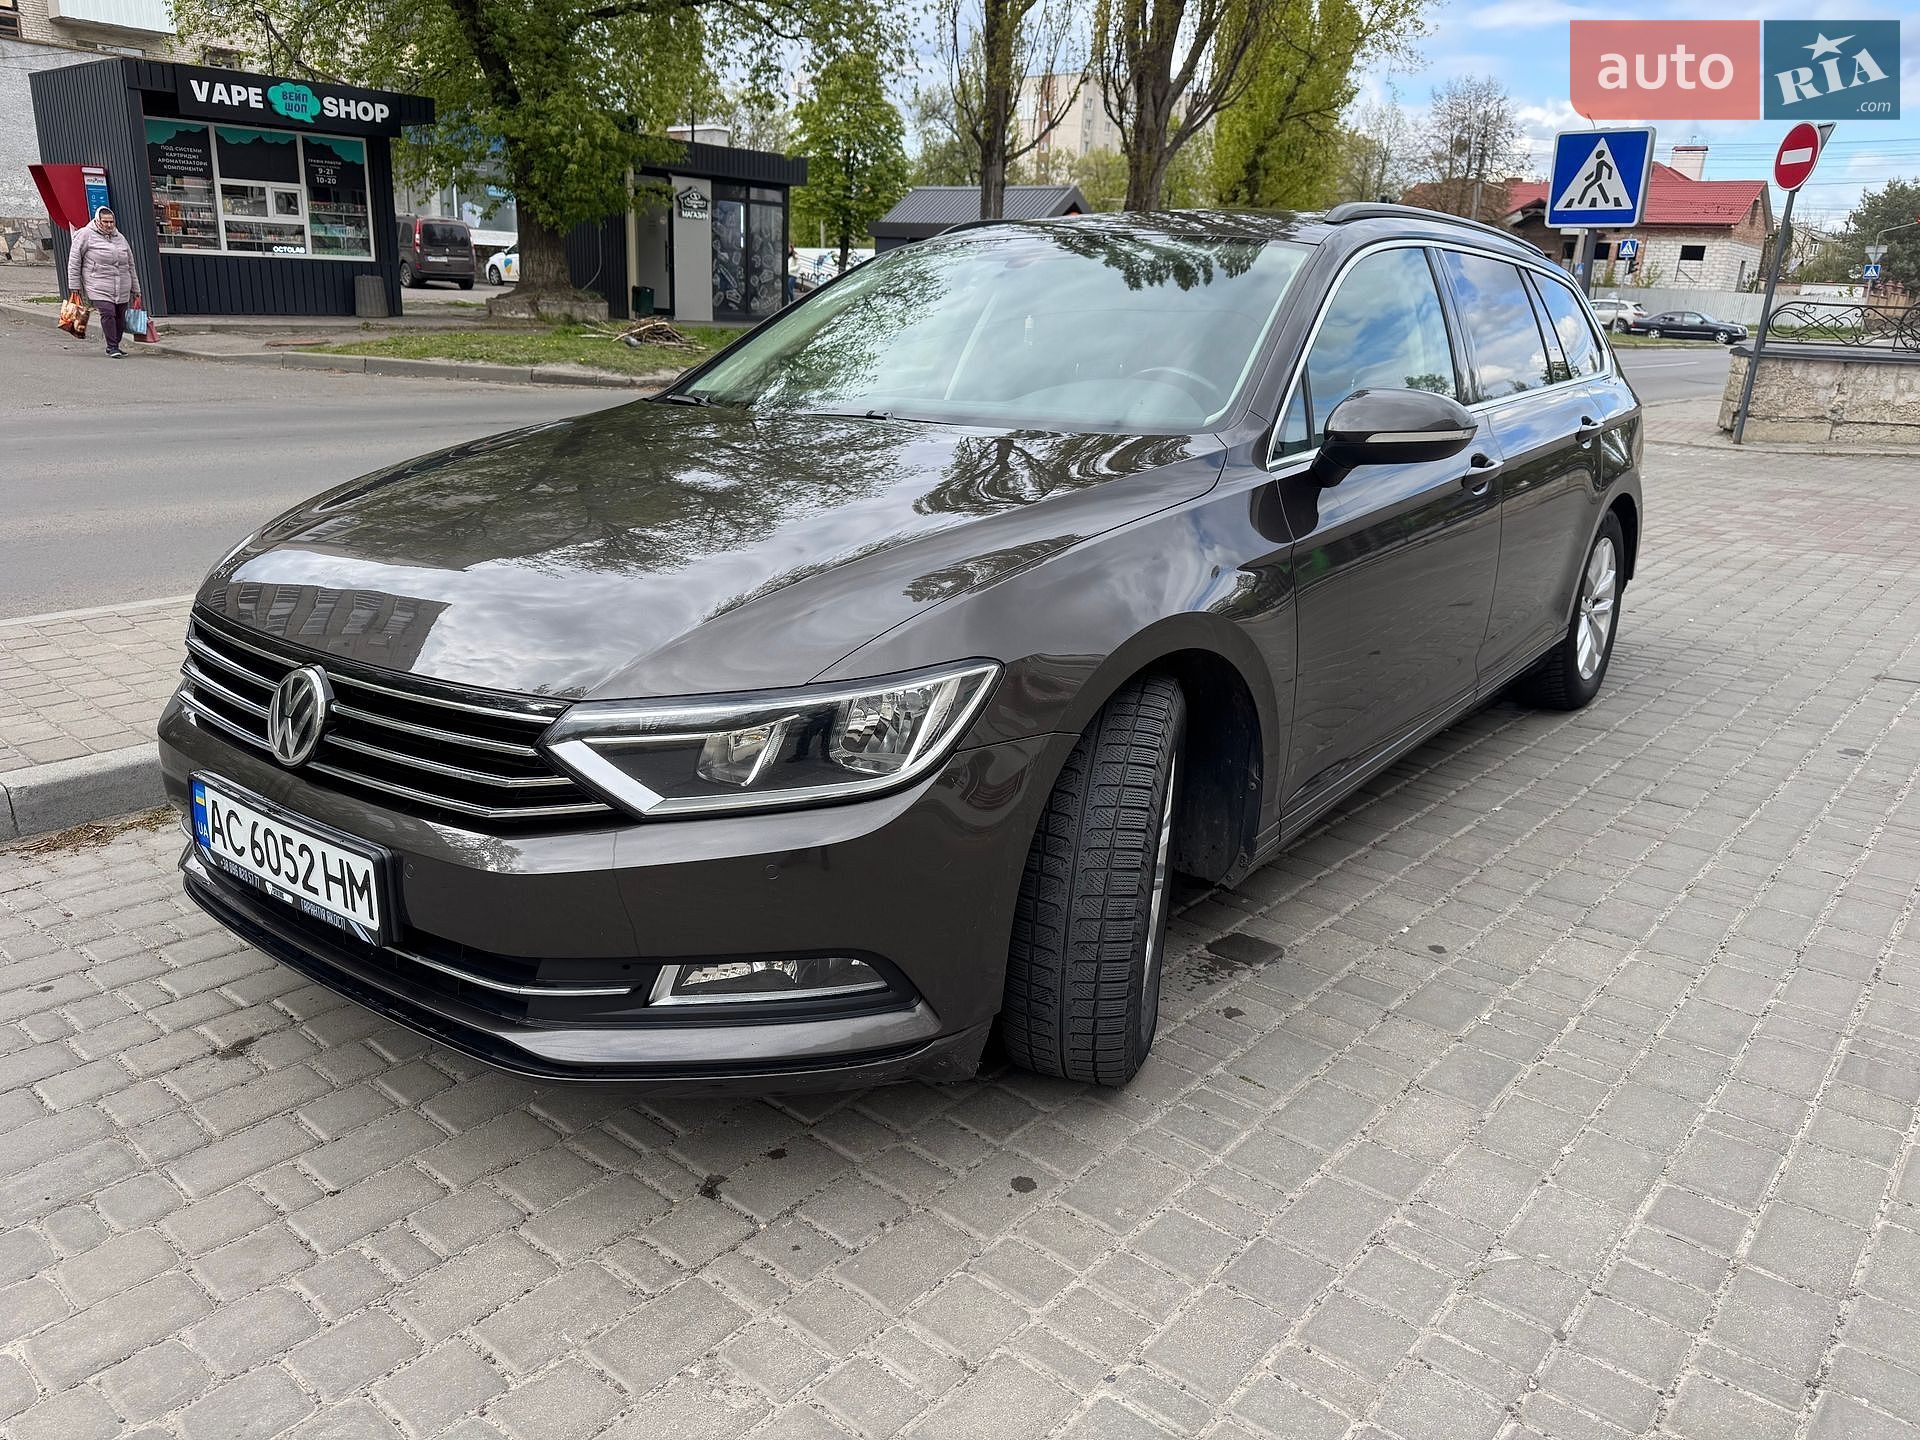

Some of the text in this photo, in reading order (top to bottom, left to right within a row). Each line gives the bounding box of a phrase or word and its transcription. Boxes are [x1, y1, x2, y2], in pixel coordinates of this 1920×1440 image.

[190, 79, 390, 123] VAPE SHOP
[282, 90, 308, 103] ВЕЙП
[285, 102, 308, 113] ШОП
[165, 152, 199, 160] КАРТРИДЖІ
[157, 157, 208, 167] АРОМАТИЗАТОРИ
[163, 164, 204, 173] КОМПОНЕНТИ
[315, 176, 338, 185] 10-20
[681, 210, 709, 220] МАГАЗИН
[272, 245, 306, 255] OCTOLAB
[197, 822, 209, 839] UA
